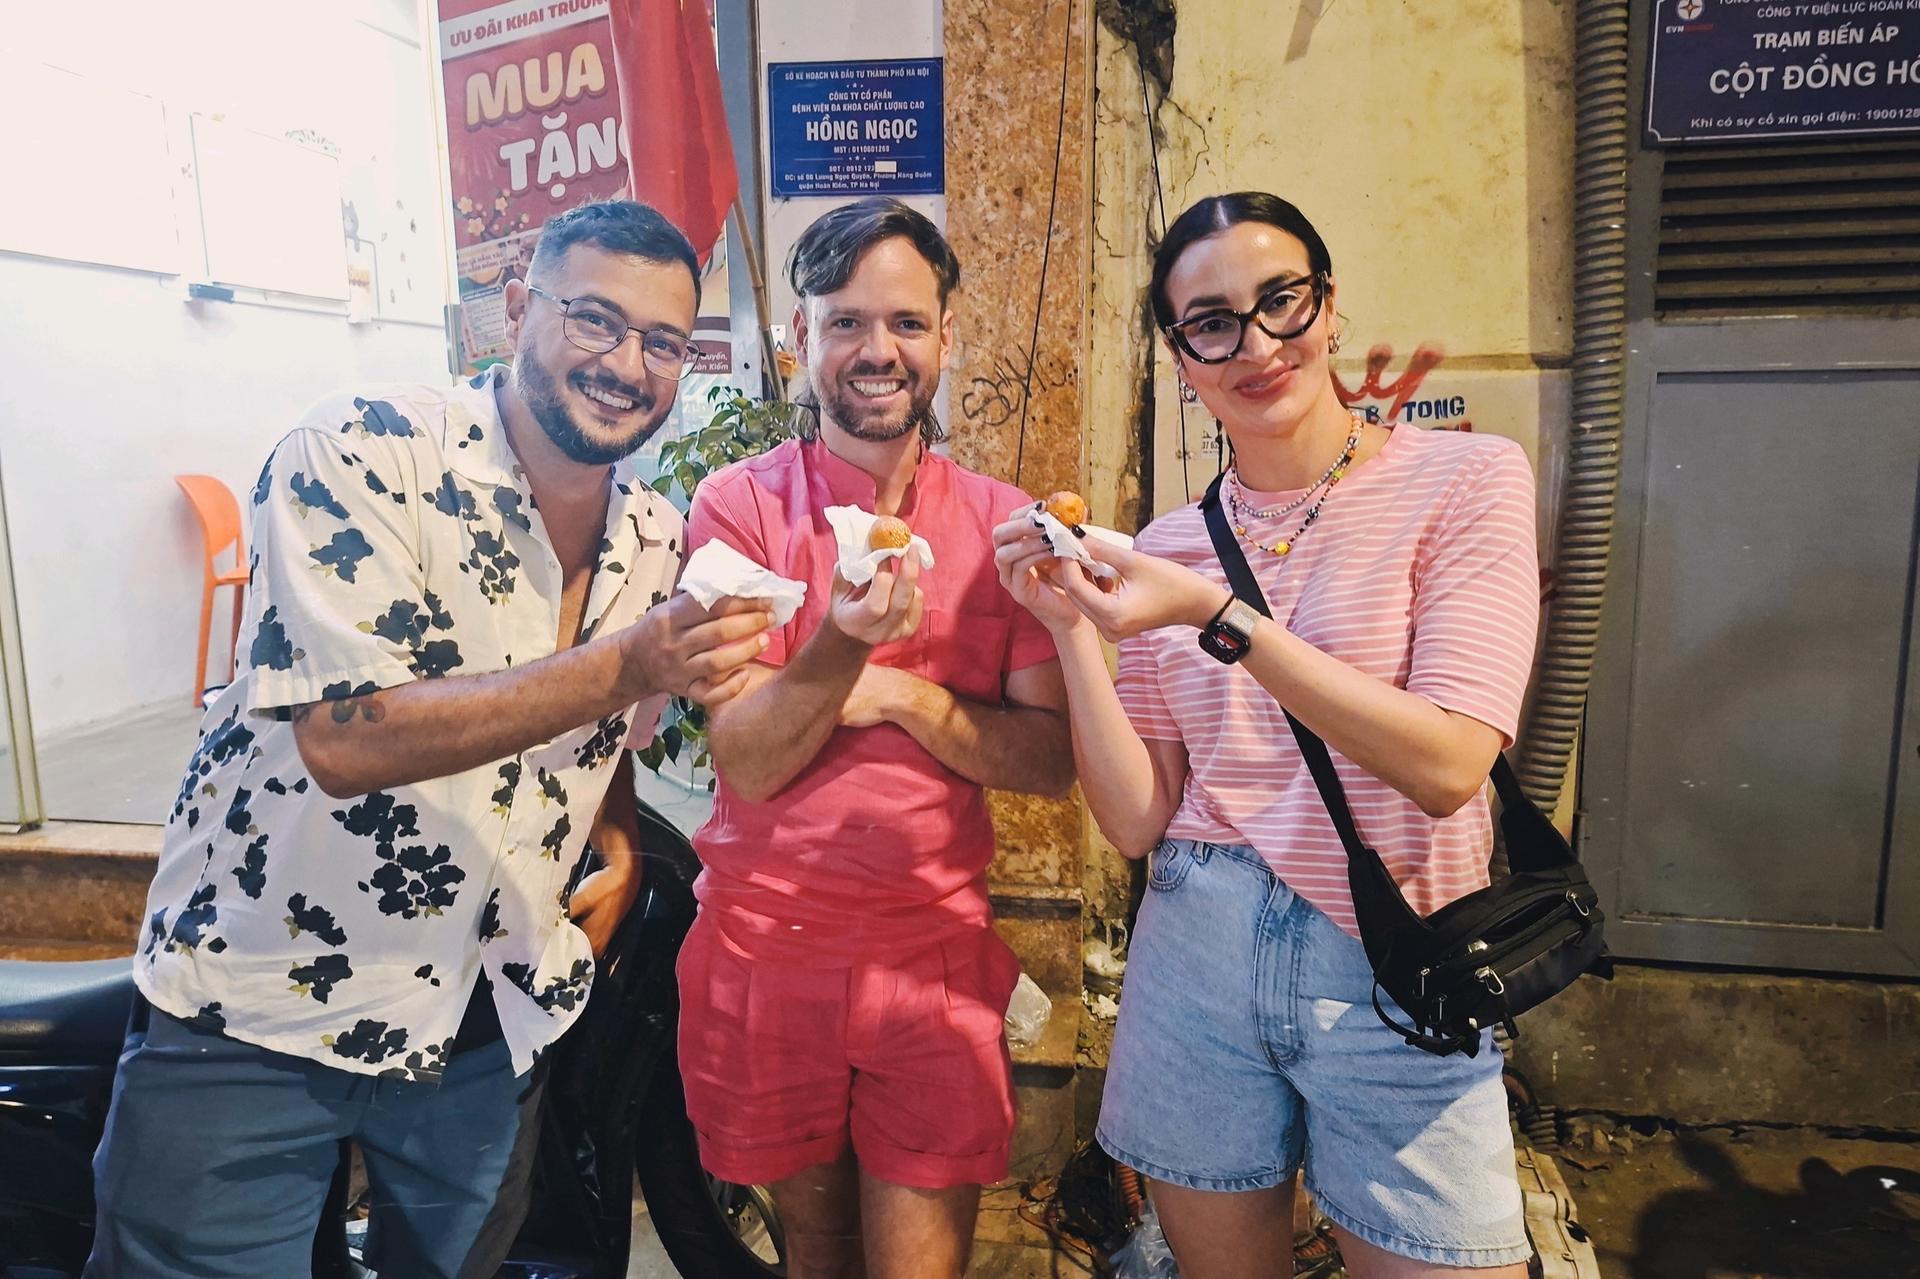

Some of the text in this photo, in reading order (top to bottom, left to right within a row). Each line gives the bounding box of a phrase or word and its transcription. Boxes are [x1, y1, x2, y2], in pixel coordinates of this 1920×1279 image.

[1757, 5, 1791, 18] CÔNG
[1795, 5, 1809, 16] TY
[1811, 2, 1839, 16] ĐIỆN
[1842, 2, 1866, 14] LỰC
[1905, 0, 1920, 10] KI
[474, 19, 502, 40] ĐÃI
[506, 8, 544, 32] KHAI
[1753, 21, 1899, 53] TRẠM BIẾN ÁP
[466, 42, 606, 126] MUA
[1710, 61, 1775, 99] CỘT
[1782, 53, 1877, 90] ĐỒNG
[792, 104, 811, 114] BỆNH
[812, 103, 829, 113] VIỆN
[842, 103, 862, 112] KHOA
[863, 101, 882, 111] CHẤT
[884, 102, 908, 112] LƯỢNG
[910, 101, 925, 110] CAO
[829, 91, 849, 101] CÔNG
[851, 92, 859, 100] TY
[806, 114, 917, 144] HỒNG NGỌC
[1690, 118, 1713, 128] Khi
[1716, 116, 1733, 127] có
[1736, 117, 1755, 128] sự
[1758, 112, 1774, 125] cố
[1778, 113, 1798, 125] xin
[1802, 112, 1823, 126] gọi
[834, 146, 847, 154] MST
[1401, 395, 1466, 422] TONG
